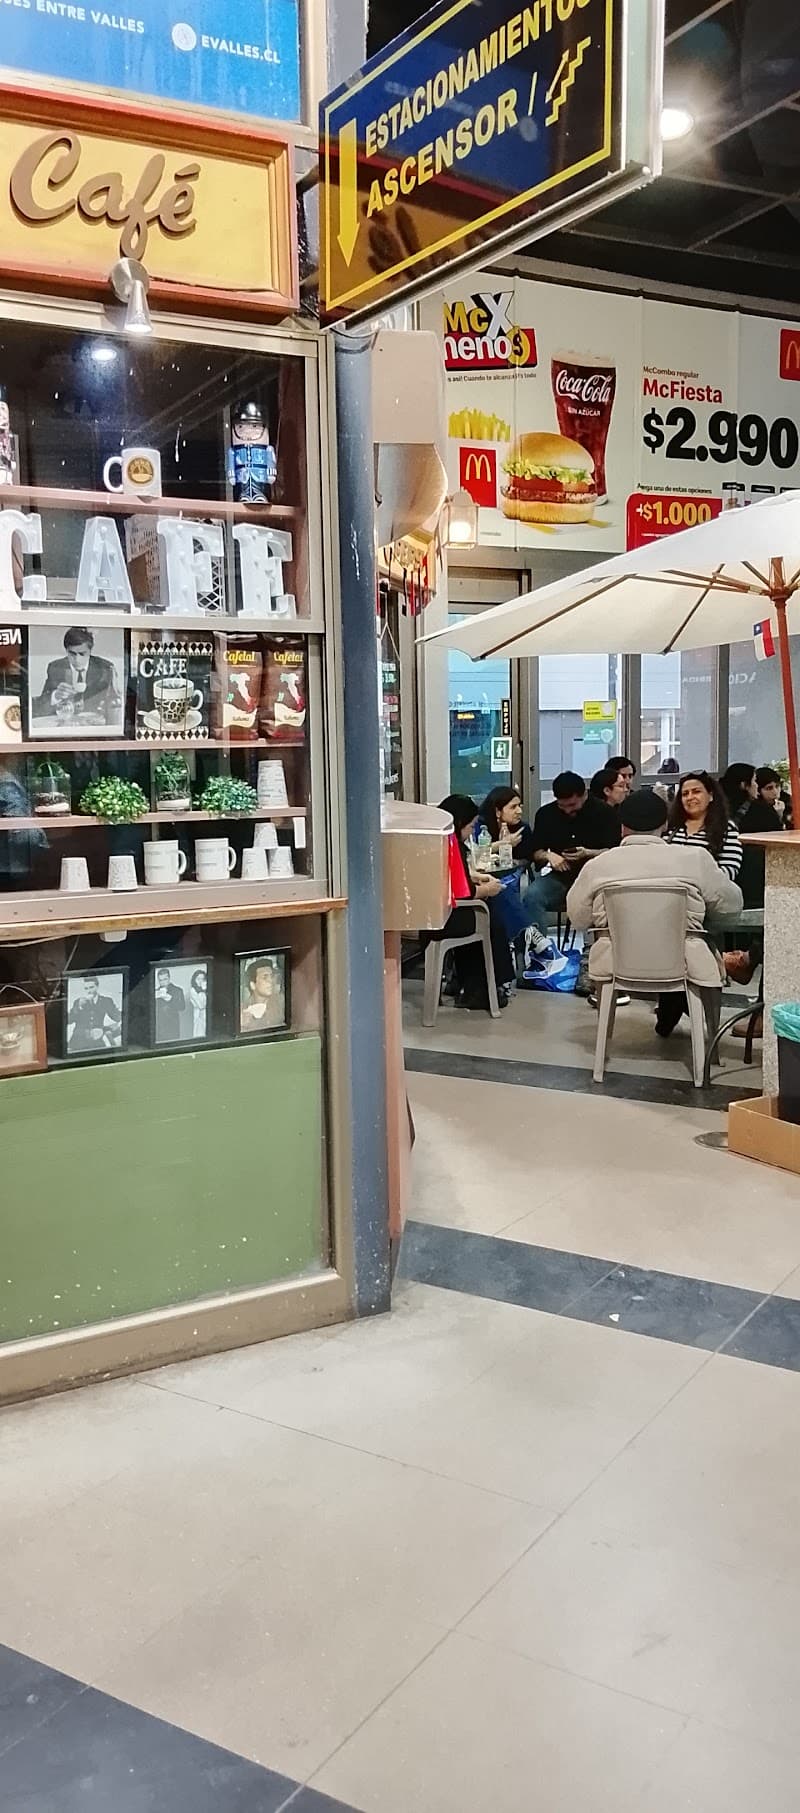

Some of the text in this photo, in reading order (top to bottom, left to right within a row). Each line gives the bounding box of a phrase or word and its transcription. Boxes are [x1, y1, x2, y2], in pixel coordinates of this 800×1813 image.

[36, 0, 86, 21] ENTRE
[90, 10, 146, 34] VALLES
[201, 34, 281, 65] EVALLES.CL
[365, 0, 591, 158] ESTACIONAMIENTO
[365, 88, 519, 219] ASCENSOR
[9, 130, 201, 261] Café
[555, 369, 614, 405] Coca-Cola
[643, 366, 700, 379] McCombo regular
[643, 377, 723, 404] McFiesta
[642, 406, 799, 469] $2.990
[636, 501, 712, 527] +$1.000
[0, 509, 297, 618] CAFE
